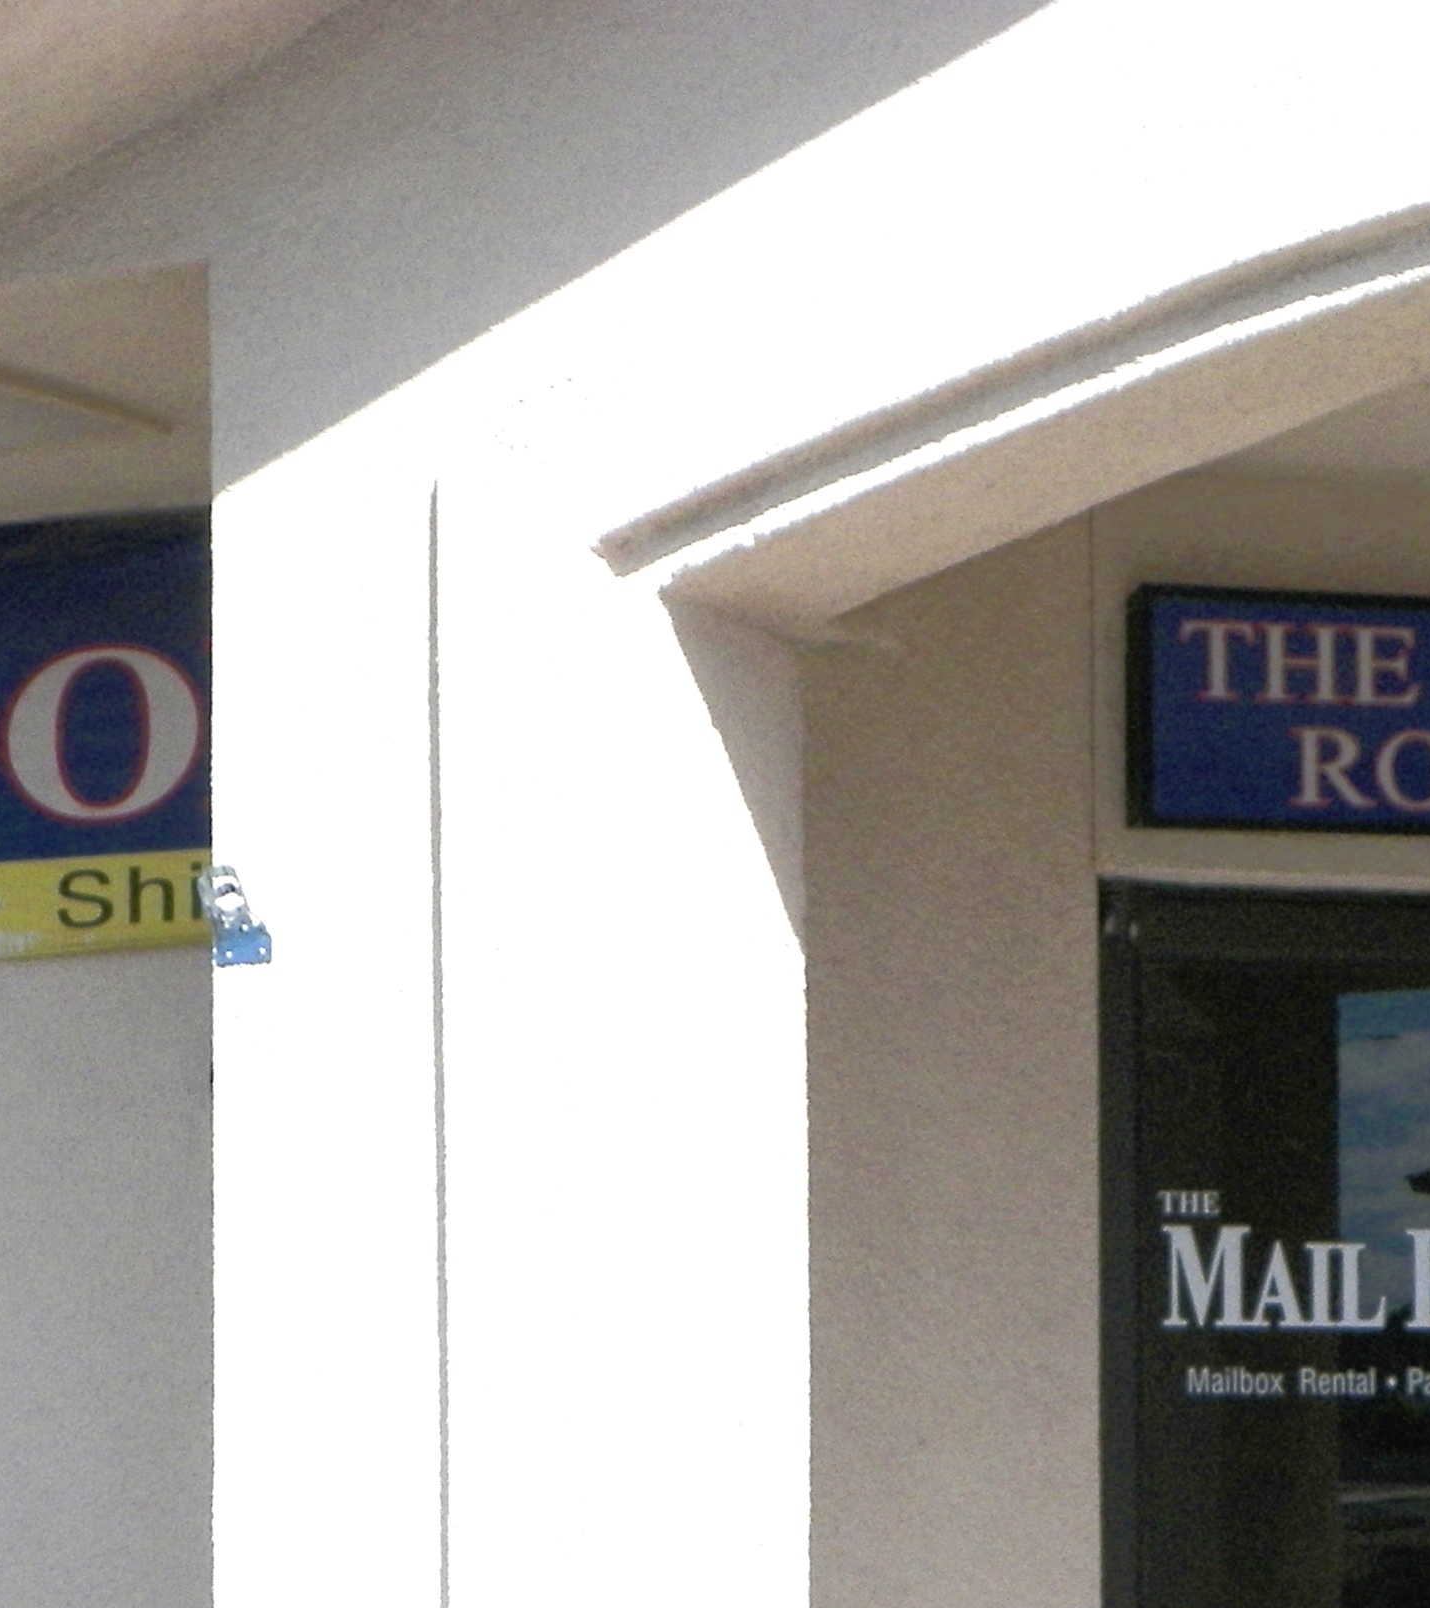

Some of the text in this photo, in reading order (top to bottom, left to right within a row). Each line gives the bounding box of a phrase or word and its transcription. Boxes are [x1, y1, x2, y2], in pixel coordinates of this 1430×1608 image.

[1178, 617, 1419, 707] THE
[57, 861, 203, 928] Shi
[1158, 1190, 1221, 1217] THE
[1161, 1223, 1388, 1329] MAIL
[1187, 1367, 1283, 1397] Mailbox
[1299, 1367, 1376, 1397] Rental
